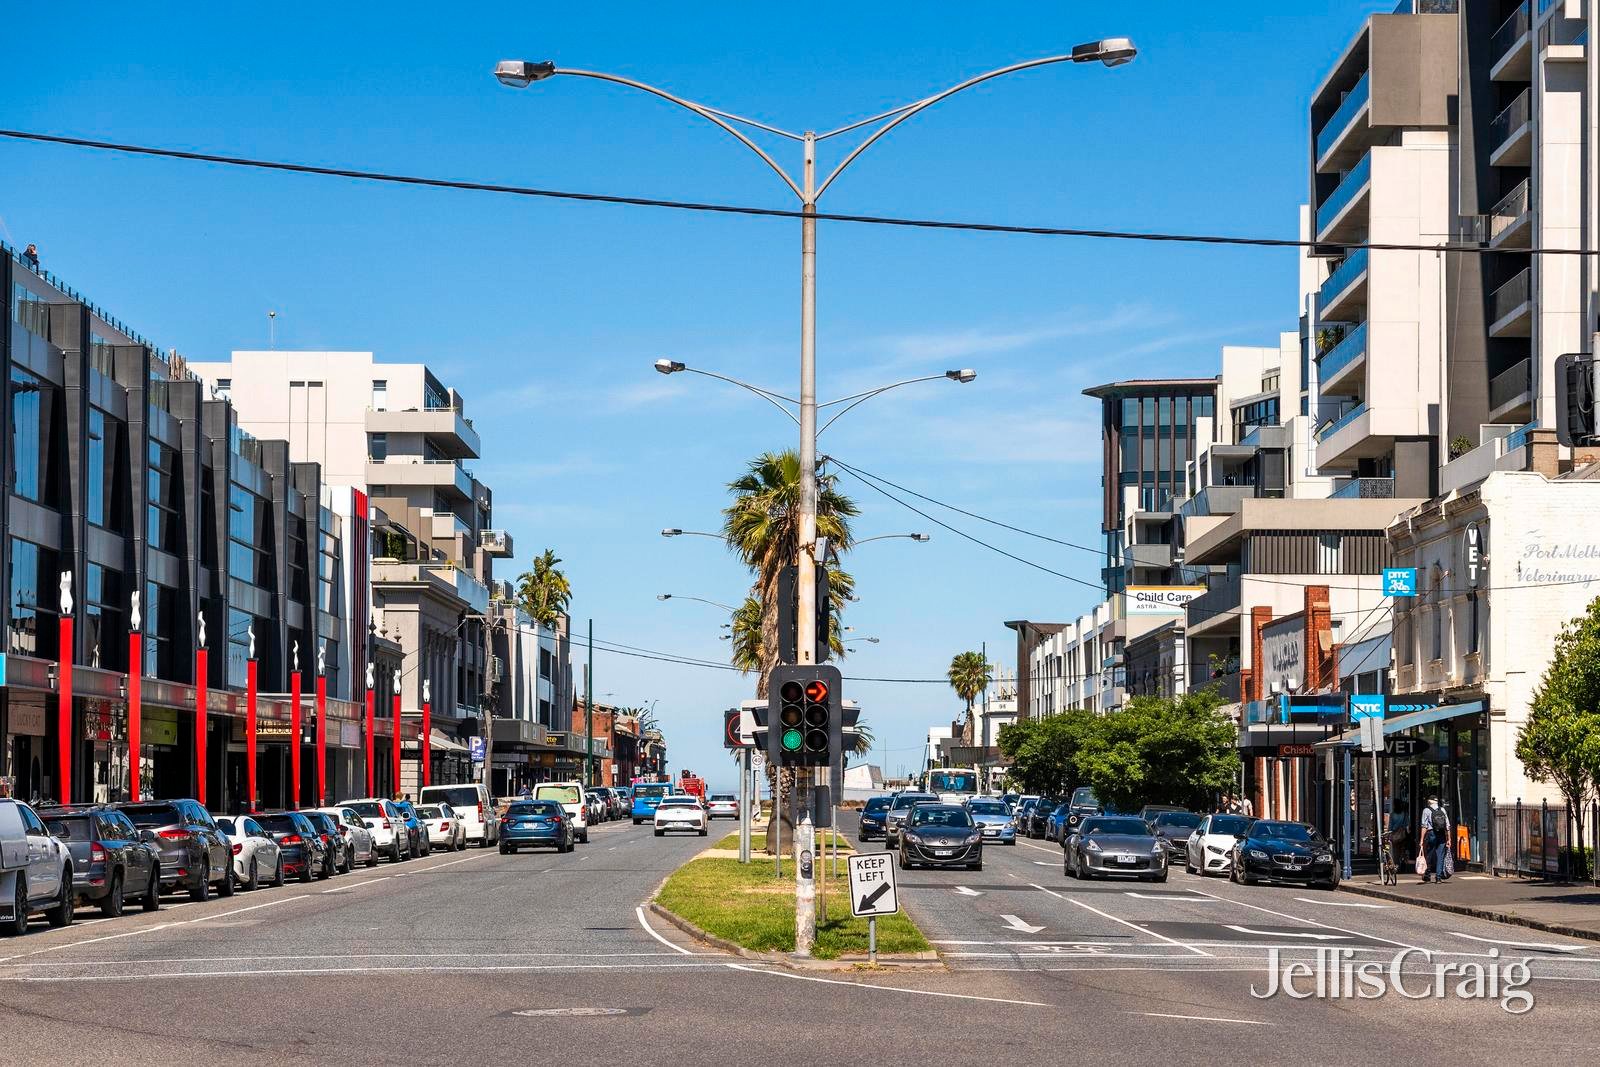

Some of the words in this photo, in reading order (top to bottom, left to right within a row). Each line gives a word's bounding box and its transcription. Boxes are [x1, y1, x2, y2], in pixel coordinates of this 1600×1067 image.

[1469, 528, 1478, 580] VET
[1523, 543, 1558, 559] Port
[1387, 571, 1410, 579] pmc
[1513, 566, 1593, 589] Veterinary
[1136, 592, 1164, 602] Child
[1166, 592, 1193, 602] Care
[1353, 703, 1381, 714] pmc
[472, 737, 482, 751] P
[1384, 740, 1417, 754] VET
[856, 858, 885, 870] KEEP
[859, 871, 885, 882] LEFT
